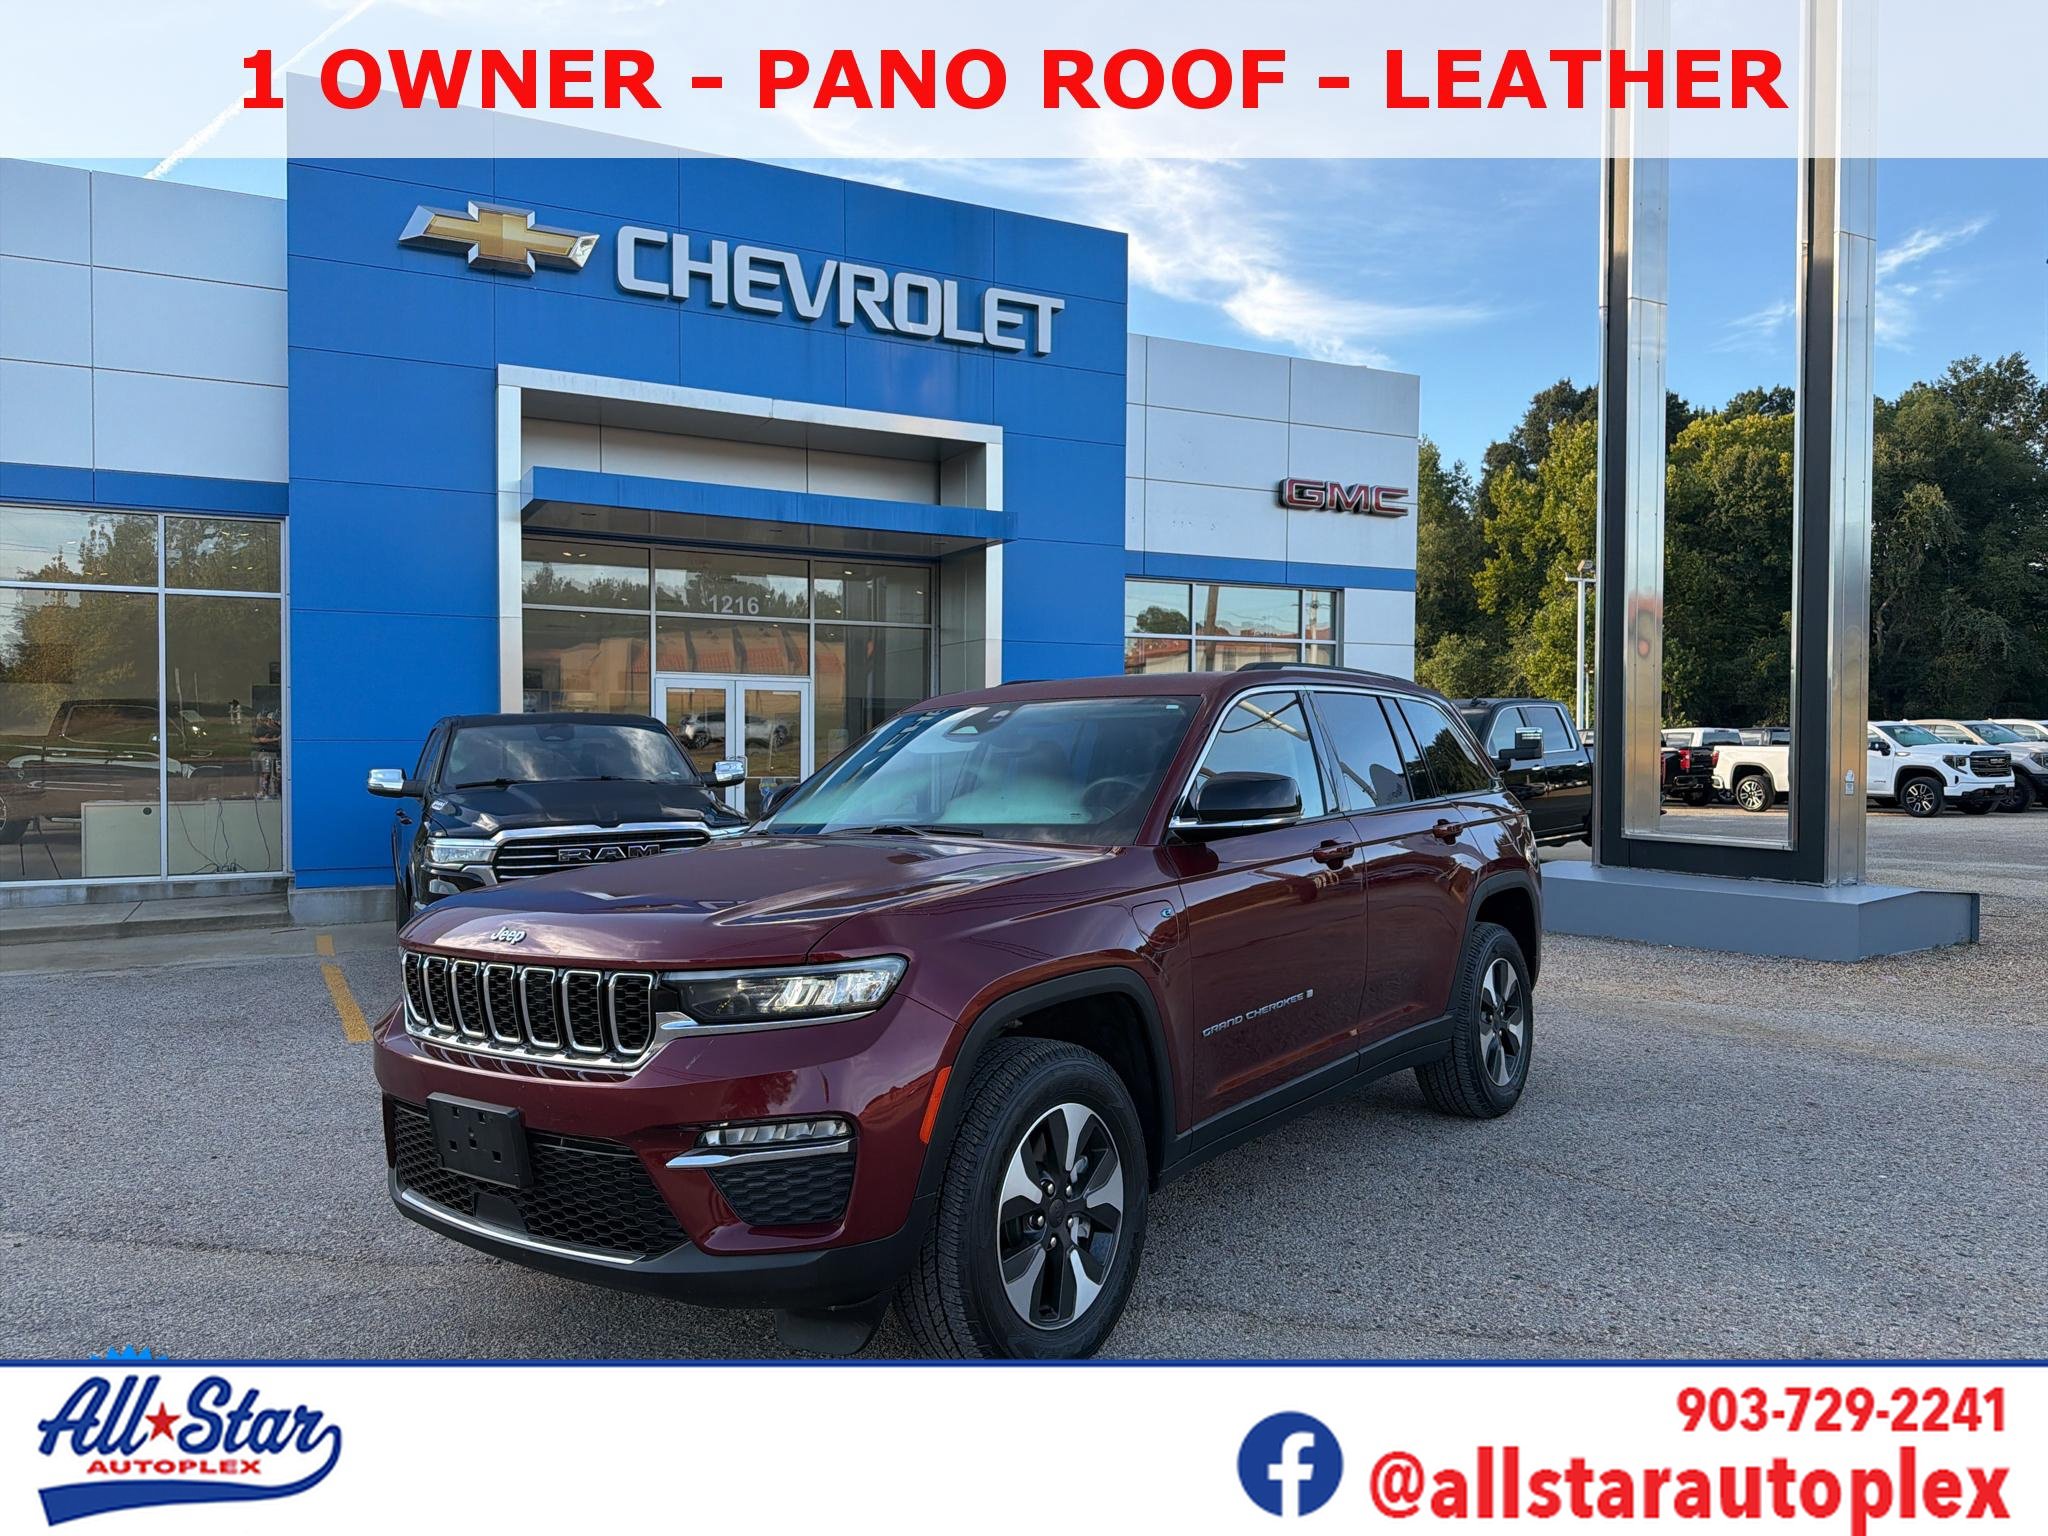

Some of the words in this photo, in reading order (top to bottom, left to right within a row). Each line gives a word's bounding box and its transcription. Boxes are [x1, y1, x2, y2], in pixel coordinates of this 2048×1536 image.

[617, 225, 1065, 355] CHEVROLET
[1280, 477, 1409, 516] GMC
[708, 594, 760, 615] 1216
[557, 844, 661, 862] RAM
[490, 926, 527, 945] Jeep
[1202, 1015, 1243, 1038] GRAND
[1245, 992, 1304, 1020] CHEROKEE
